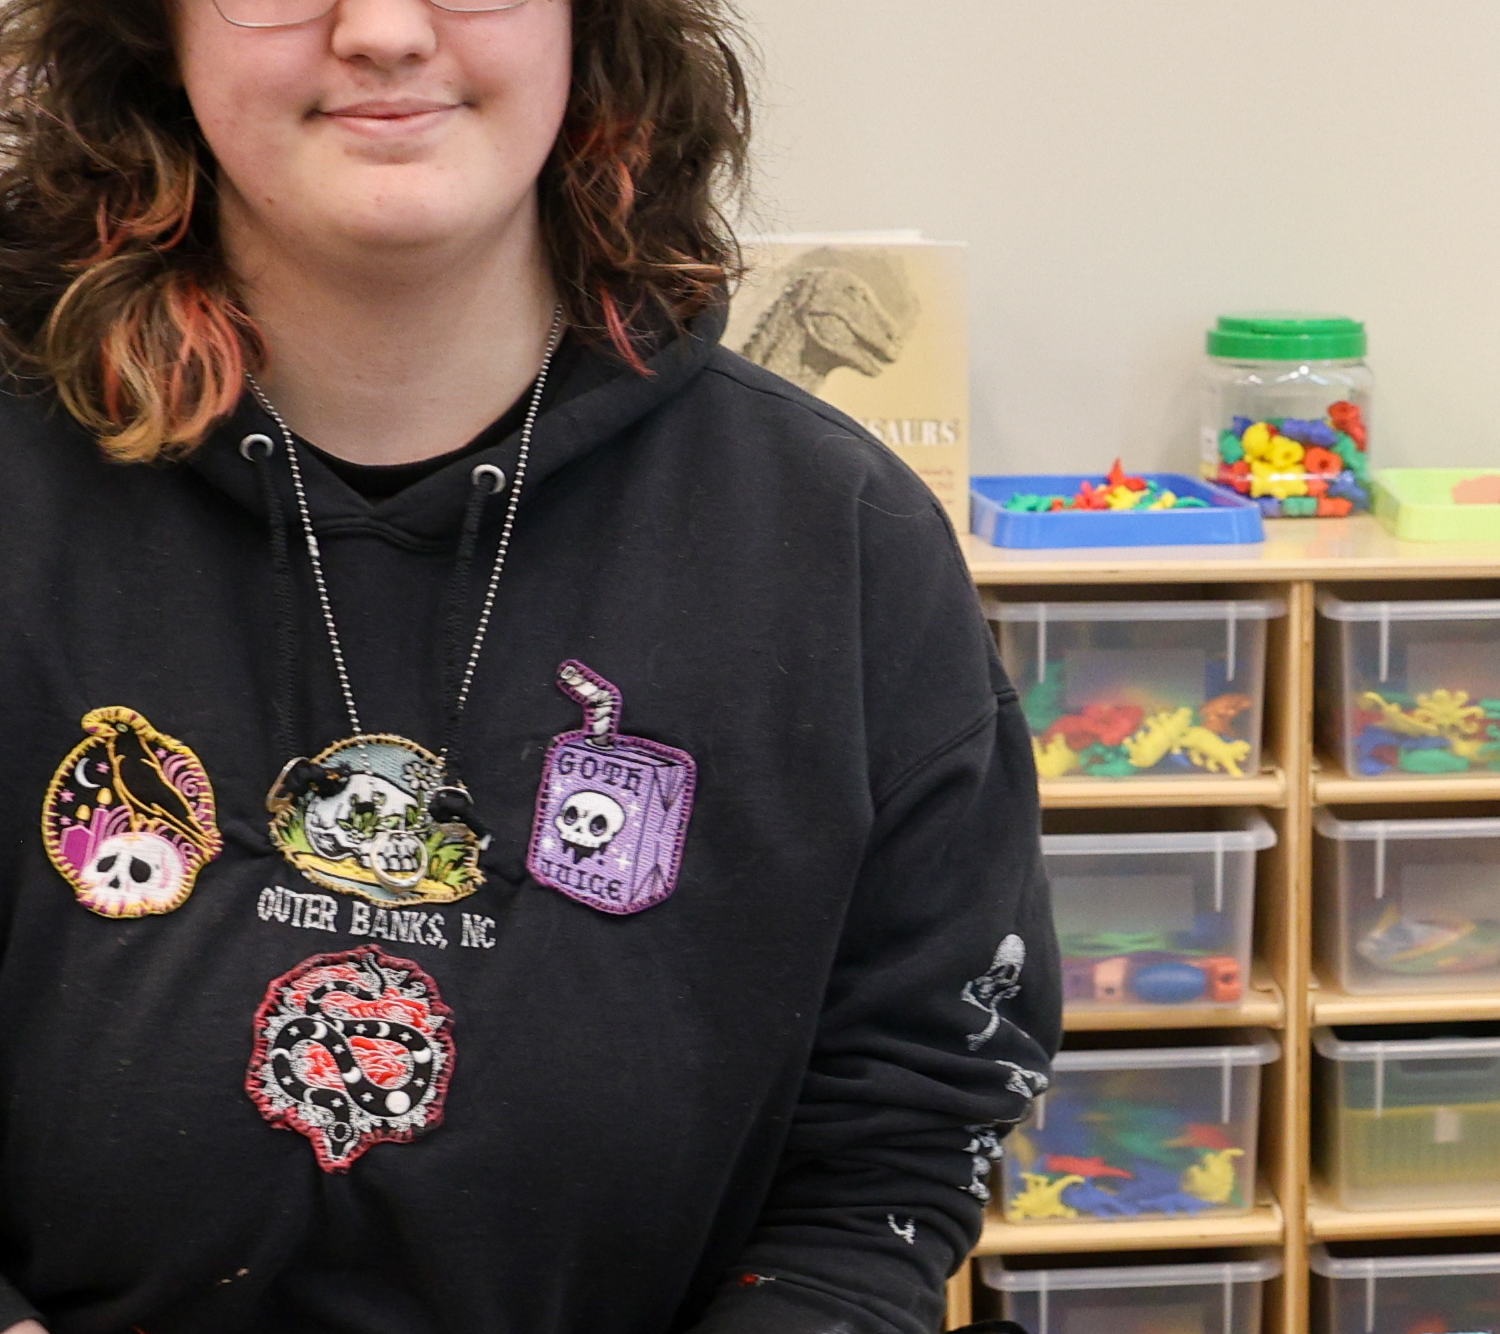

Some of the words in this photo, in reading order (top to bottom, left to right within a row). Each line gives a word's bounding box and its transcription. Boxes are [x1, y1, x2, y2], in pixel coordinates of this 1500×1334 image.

[540, 857, 623, 901] JUICE
[257, 885, 338, 933] OUTER
[349, 900, 448, 950] BANKS,
[460, 912, 497, 949] NC
